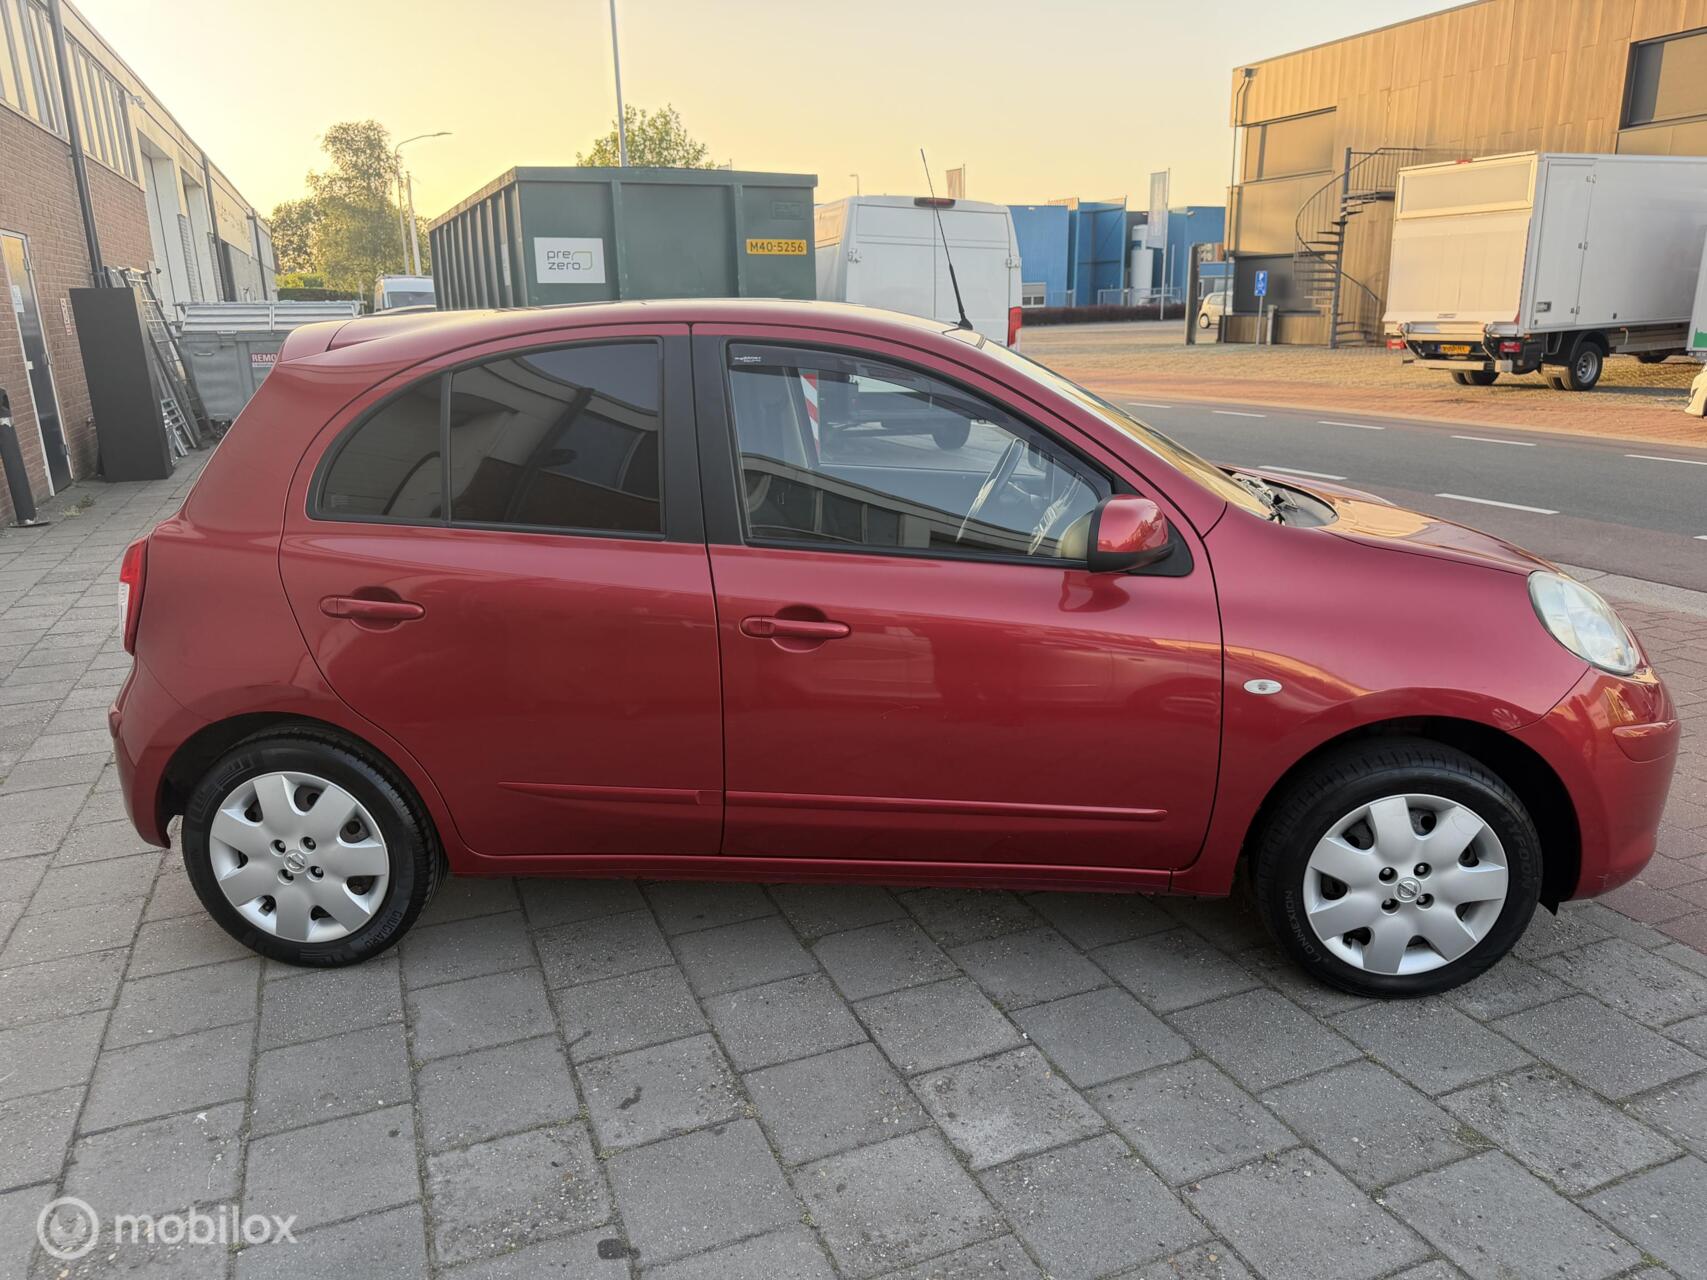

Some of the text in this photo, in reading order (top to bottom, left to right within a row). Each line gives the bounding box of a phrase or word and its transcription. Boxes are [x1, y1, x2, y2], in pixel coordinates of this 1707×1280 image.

[750, 241, 803, 253] M40-5256
[547, 251, 571, 261] pre
[547, 262, 581, 270] zero
